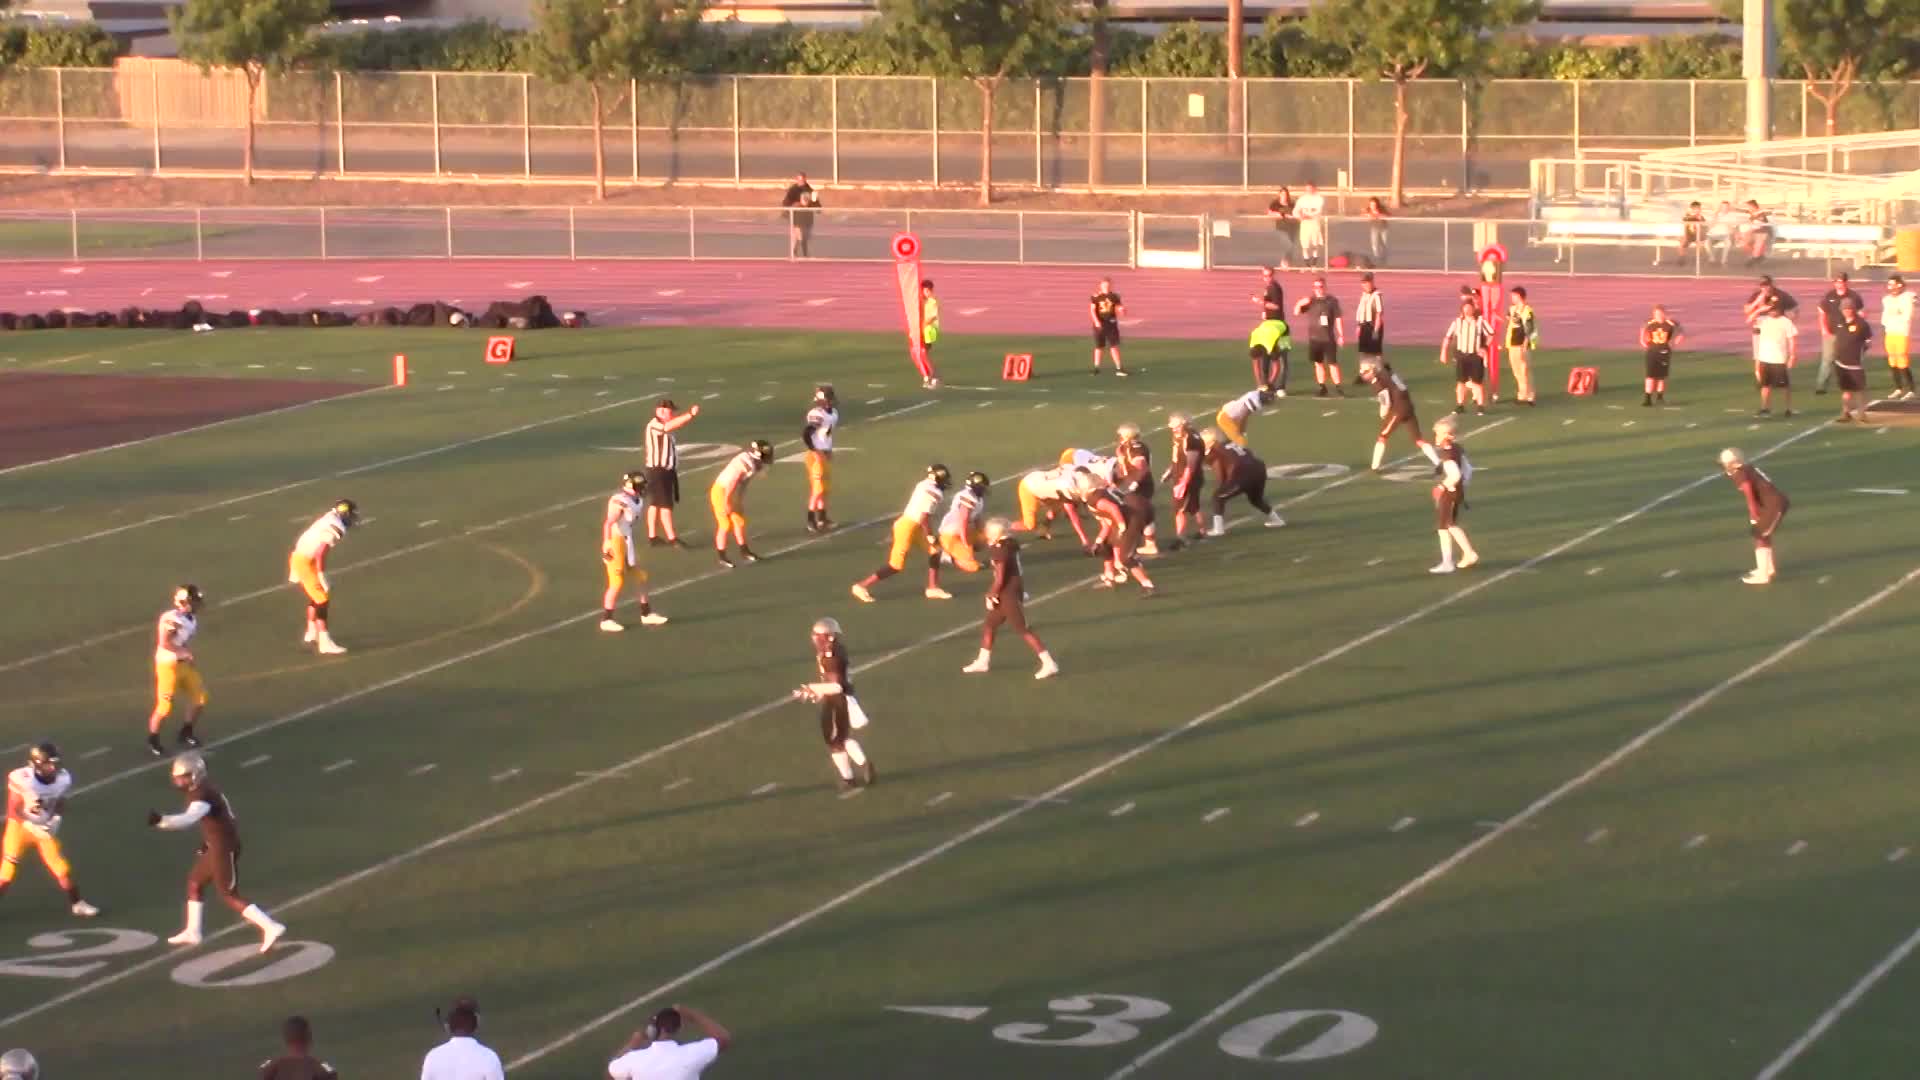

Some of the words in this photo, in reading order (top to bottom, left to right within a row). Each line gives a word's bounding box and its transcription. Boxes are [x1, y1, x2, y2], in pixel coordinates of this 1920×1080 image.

[491, 340, 508, 359] G
[1007, 357, 1027, 377] 10
[1571, 371, 1593, 393] 20
[0, 928, 336, 988] 20
[992, 994, 1379, 1061] 30
